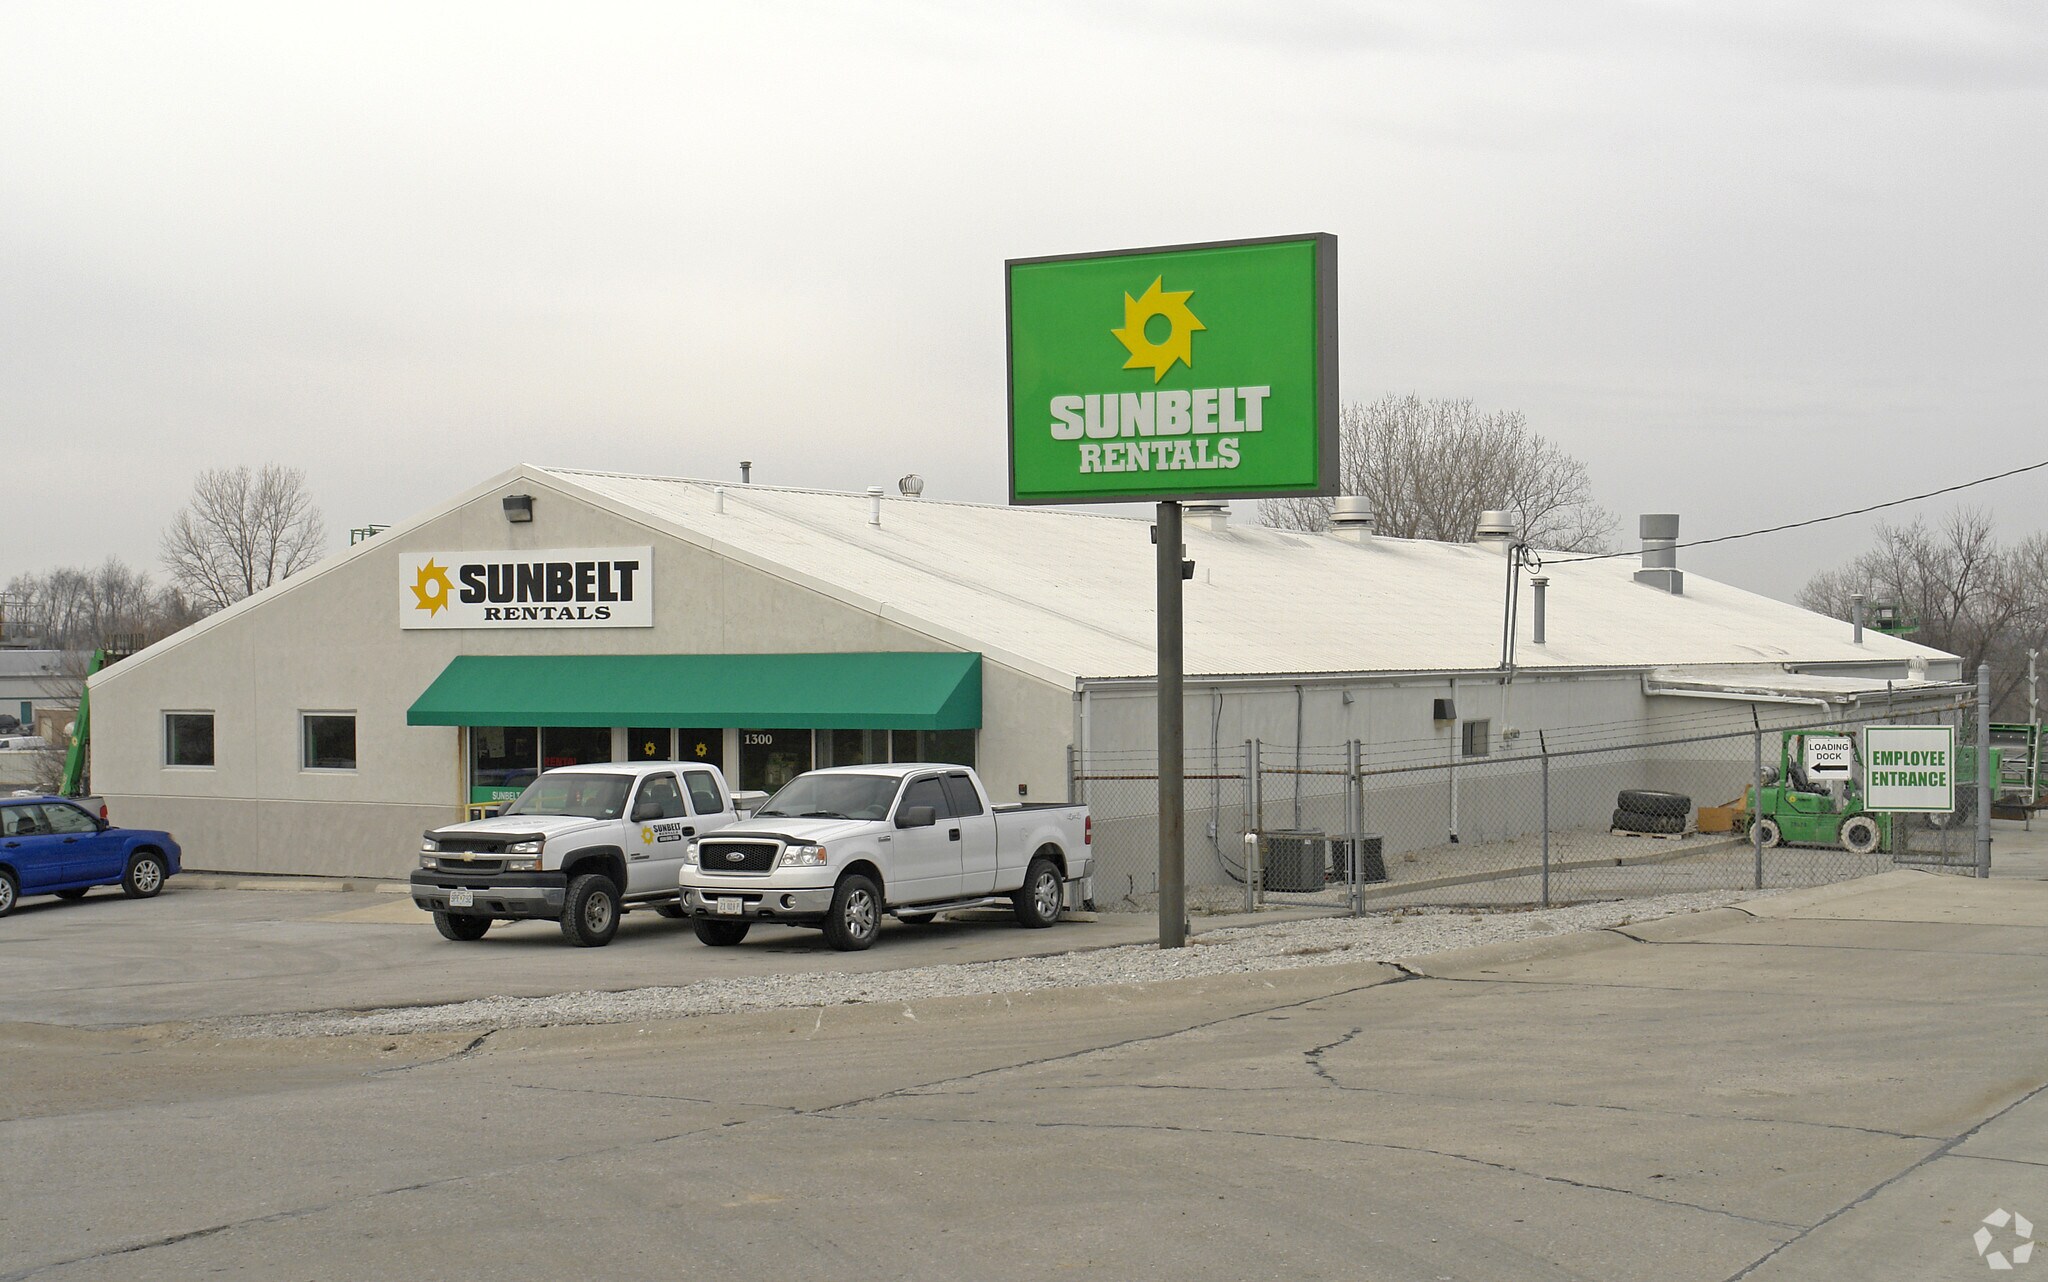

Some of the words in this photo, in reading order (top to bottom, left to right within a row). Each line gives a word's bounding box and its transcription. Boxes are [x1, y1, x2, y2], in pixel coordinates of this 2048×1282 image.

[1050, 385, 1271, 440] SUNBELT
[1079, 438, 1241, 473] RENTALS
[459, 561, 639, 604] SUNBELT
[484, 606, 611, 621] RENTALS
[744, 733, 773, 745] 1300
[1809, 743, 1849, 751] LOADING
[1872, 750, 1946, 766] EMPLOYEE
[1871, 771, 1947, 787] ENTRANCE
[653, 822, 681, 833] SUNBELT
